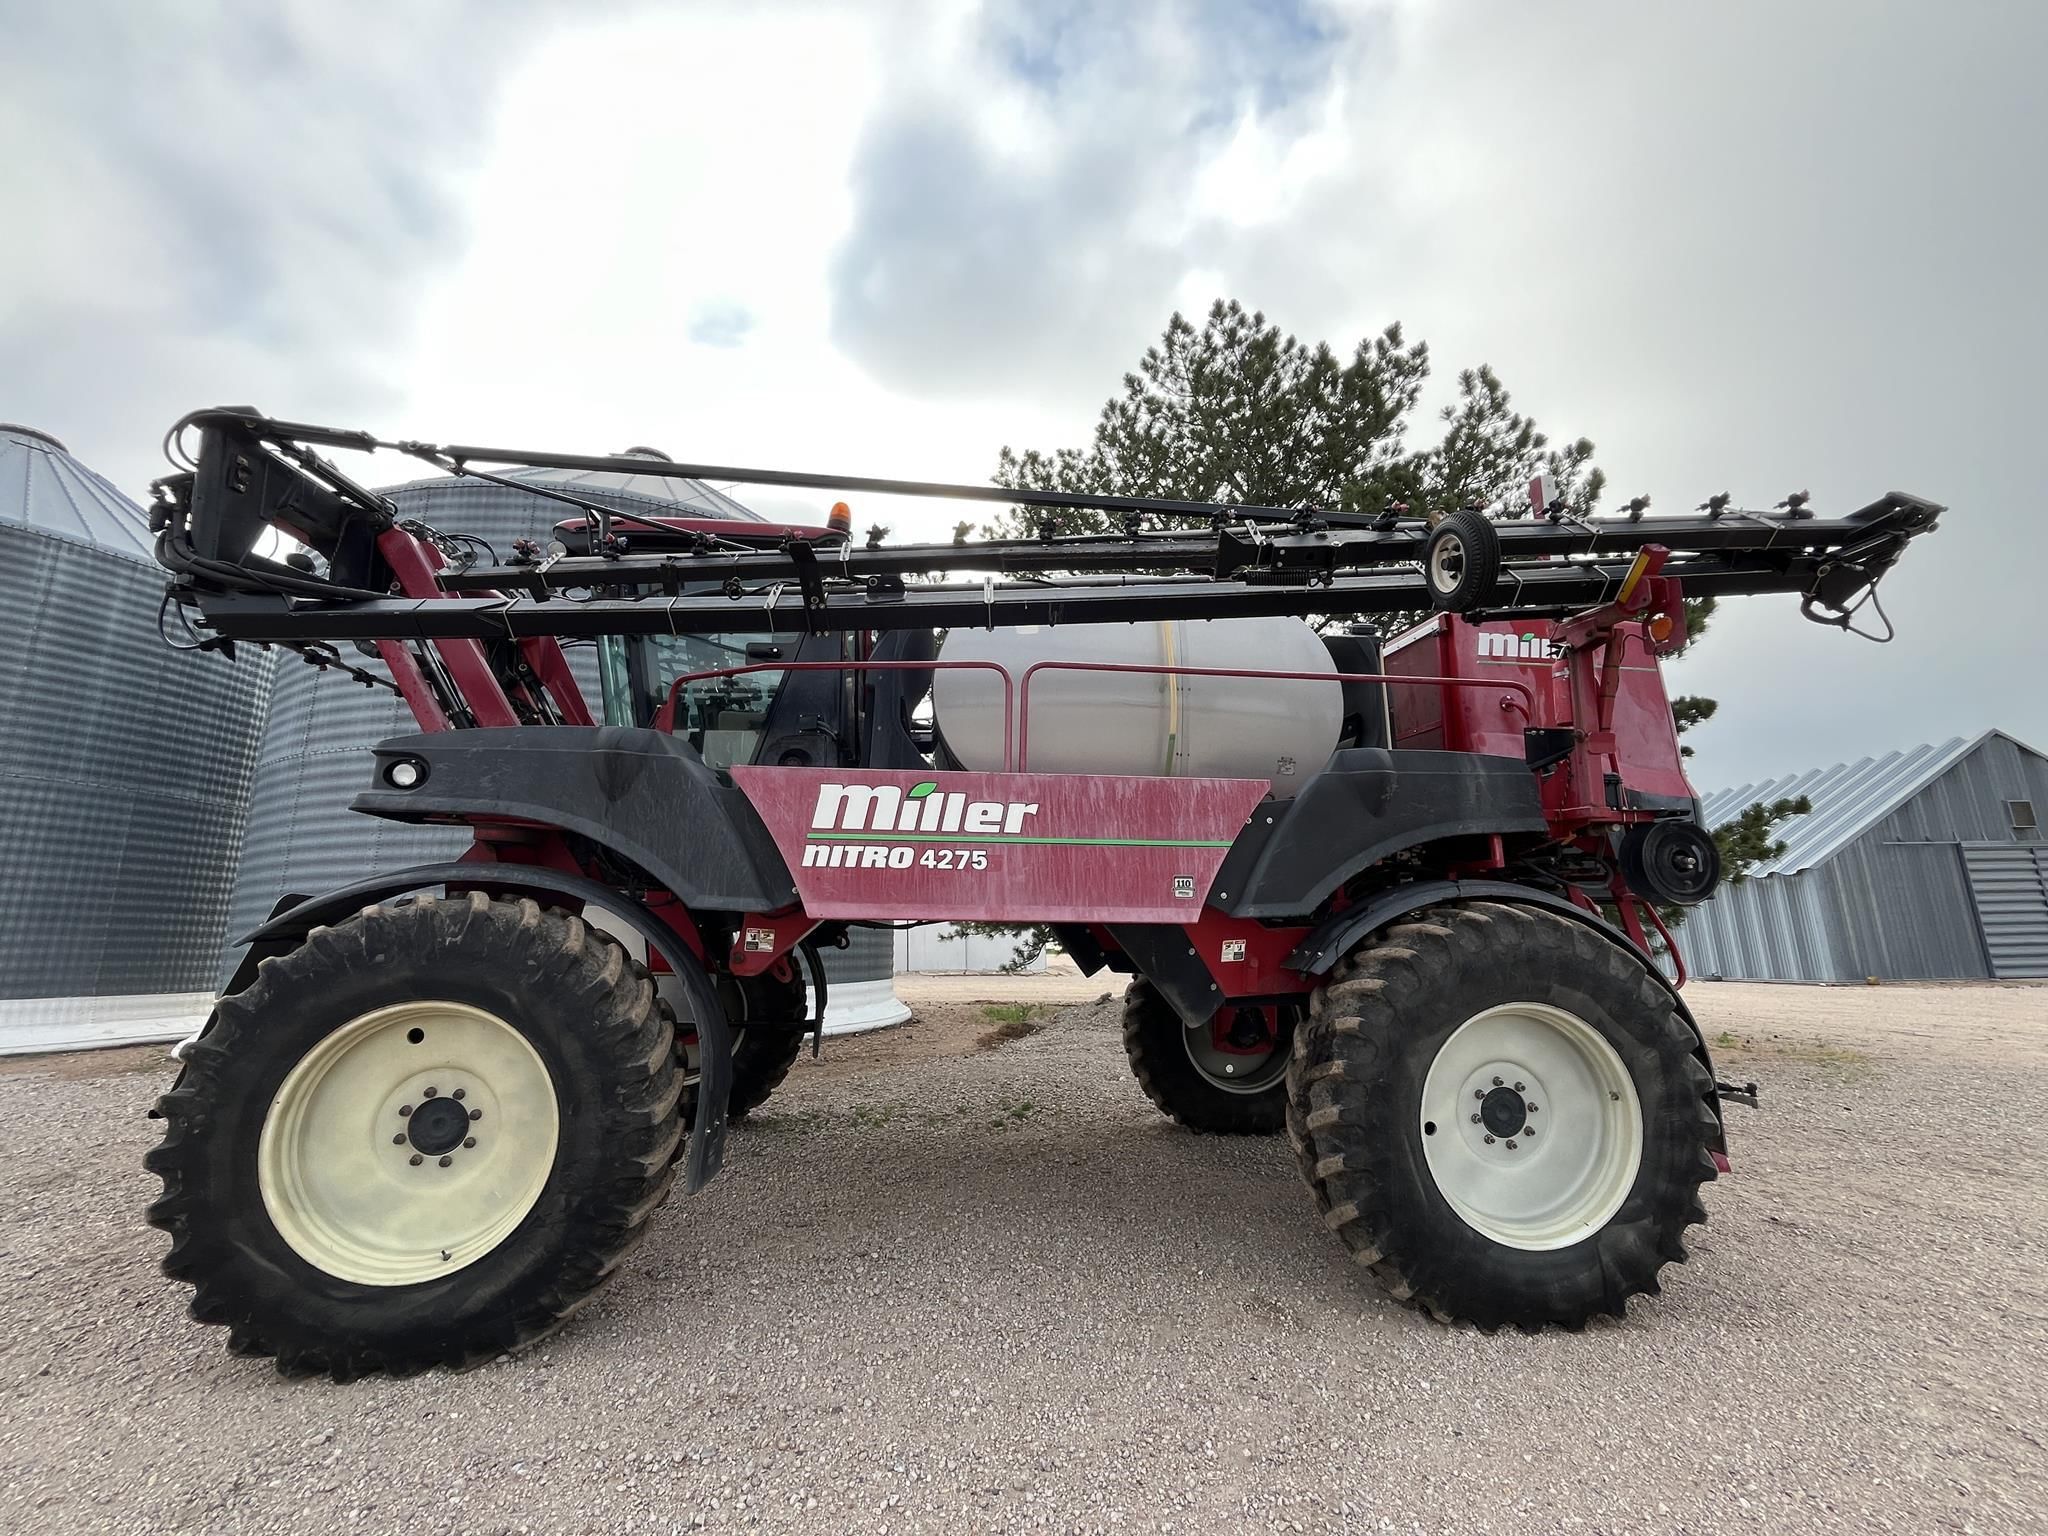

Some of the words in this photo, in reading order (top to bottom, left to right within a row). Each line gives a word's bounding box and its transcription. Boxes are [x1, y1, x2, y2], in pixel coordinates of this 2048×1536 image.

[801, 844, 915, 870] NITRO
[919, 849, 988, 871] 4275
[1176, 879, 1191, 888] 110
